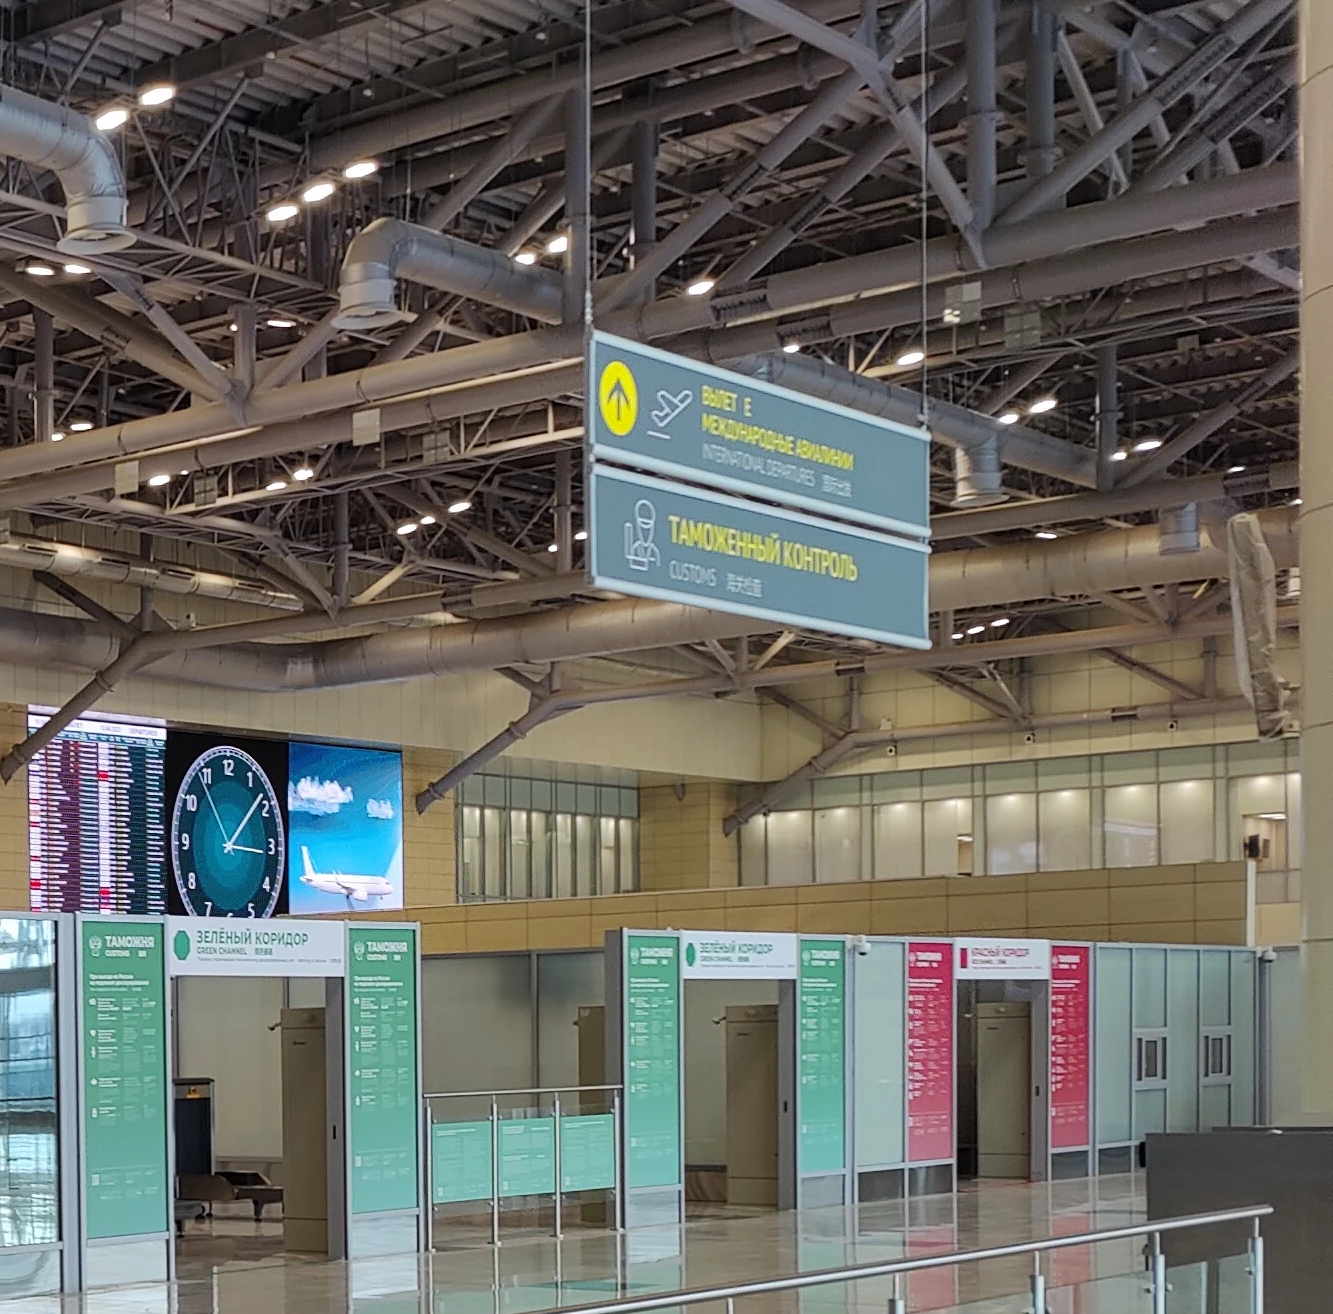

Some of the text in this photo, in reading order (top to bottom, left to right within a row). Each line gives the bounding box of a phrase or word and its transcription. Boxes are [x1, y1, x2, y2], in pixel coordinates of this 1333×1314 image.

[701, 384, 738, 412] ВЫЛЕТ
[668, 515, 858, 582] ТАМОЖЕННЫЙ КОНТРОЛЬ
[669, 560, 717, 587] CUSTOMS
[202, 768, 212, 784] 11
[222, 760, 234, 776] 12
[247, 772, 253, 787] 1
[186, 794, 197, 811] 10
[262, 800, 269, 817] 2
[182, 833, 189, 850] 9
[268, 838, 275, 855] 3
[188, 872, 196, 889] 8
[262, 876, 270, 892] 4
[204, 902, 212, 917] 7
[248, 903, 255, 918] 5
[197, 928, 308, 947] ЗЕЛЁНЫЙ КОРИДОР
